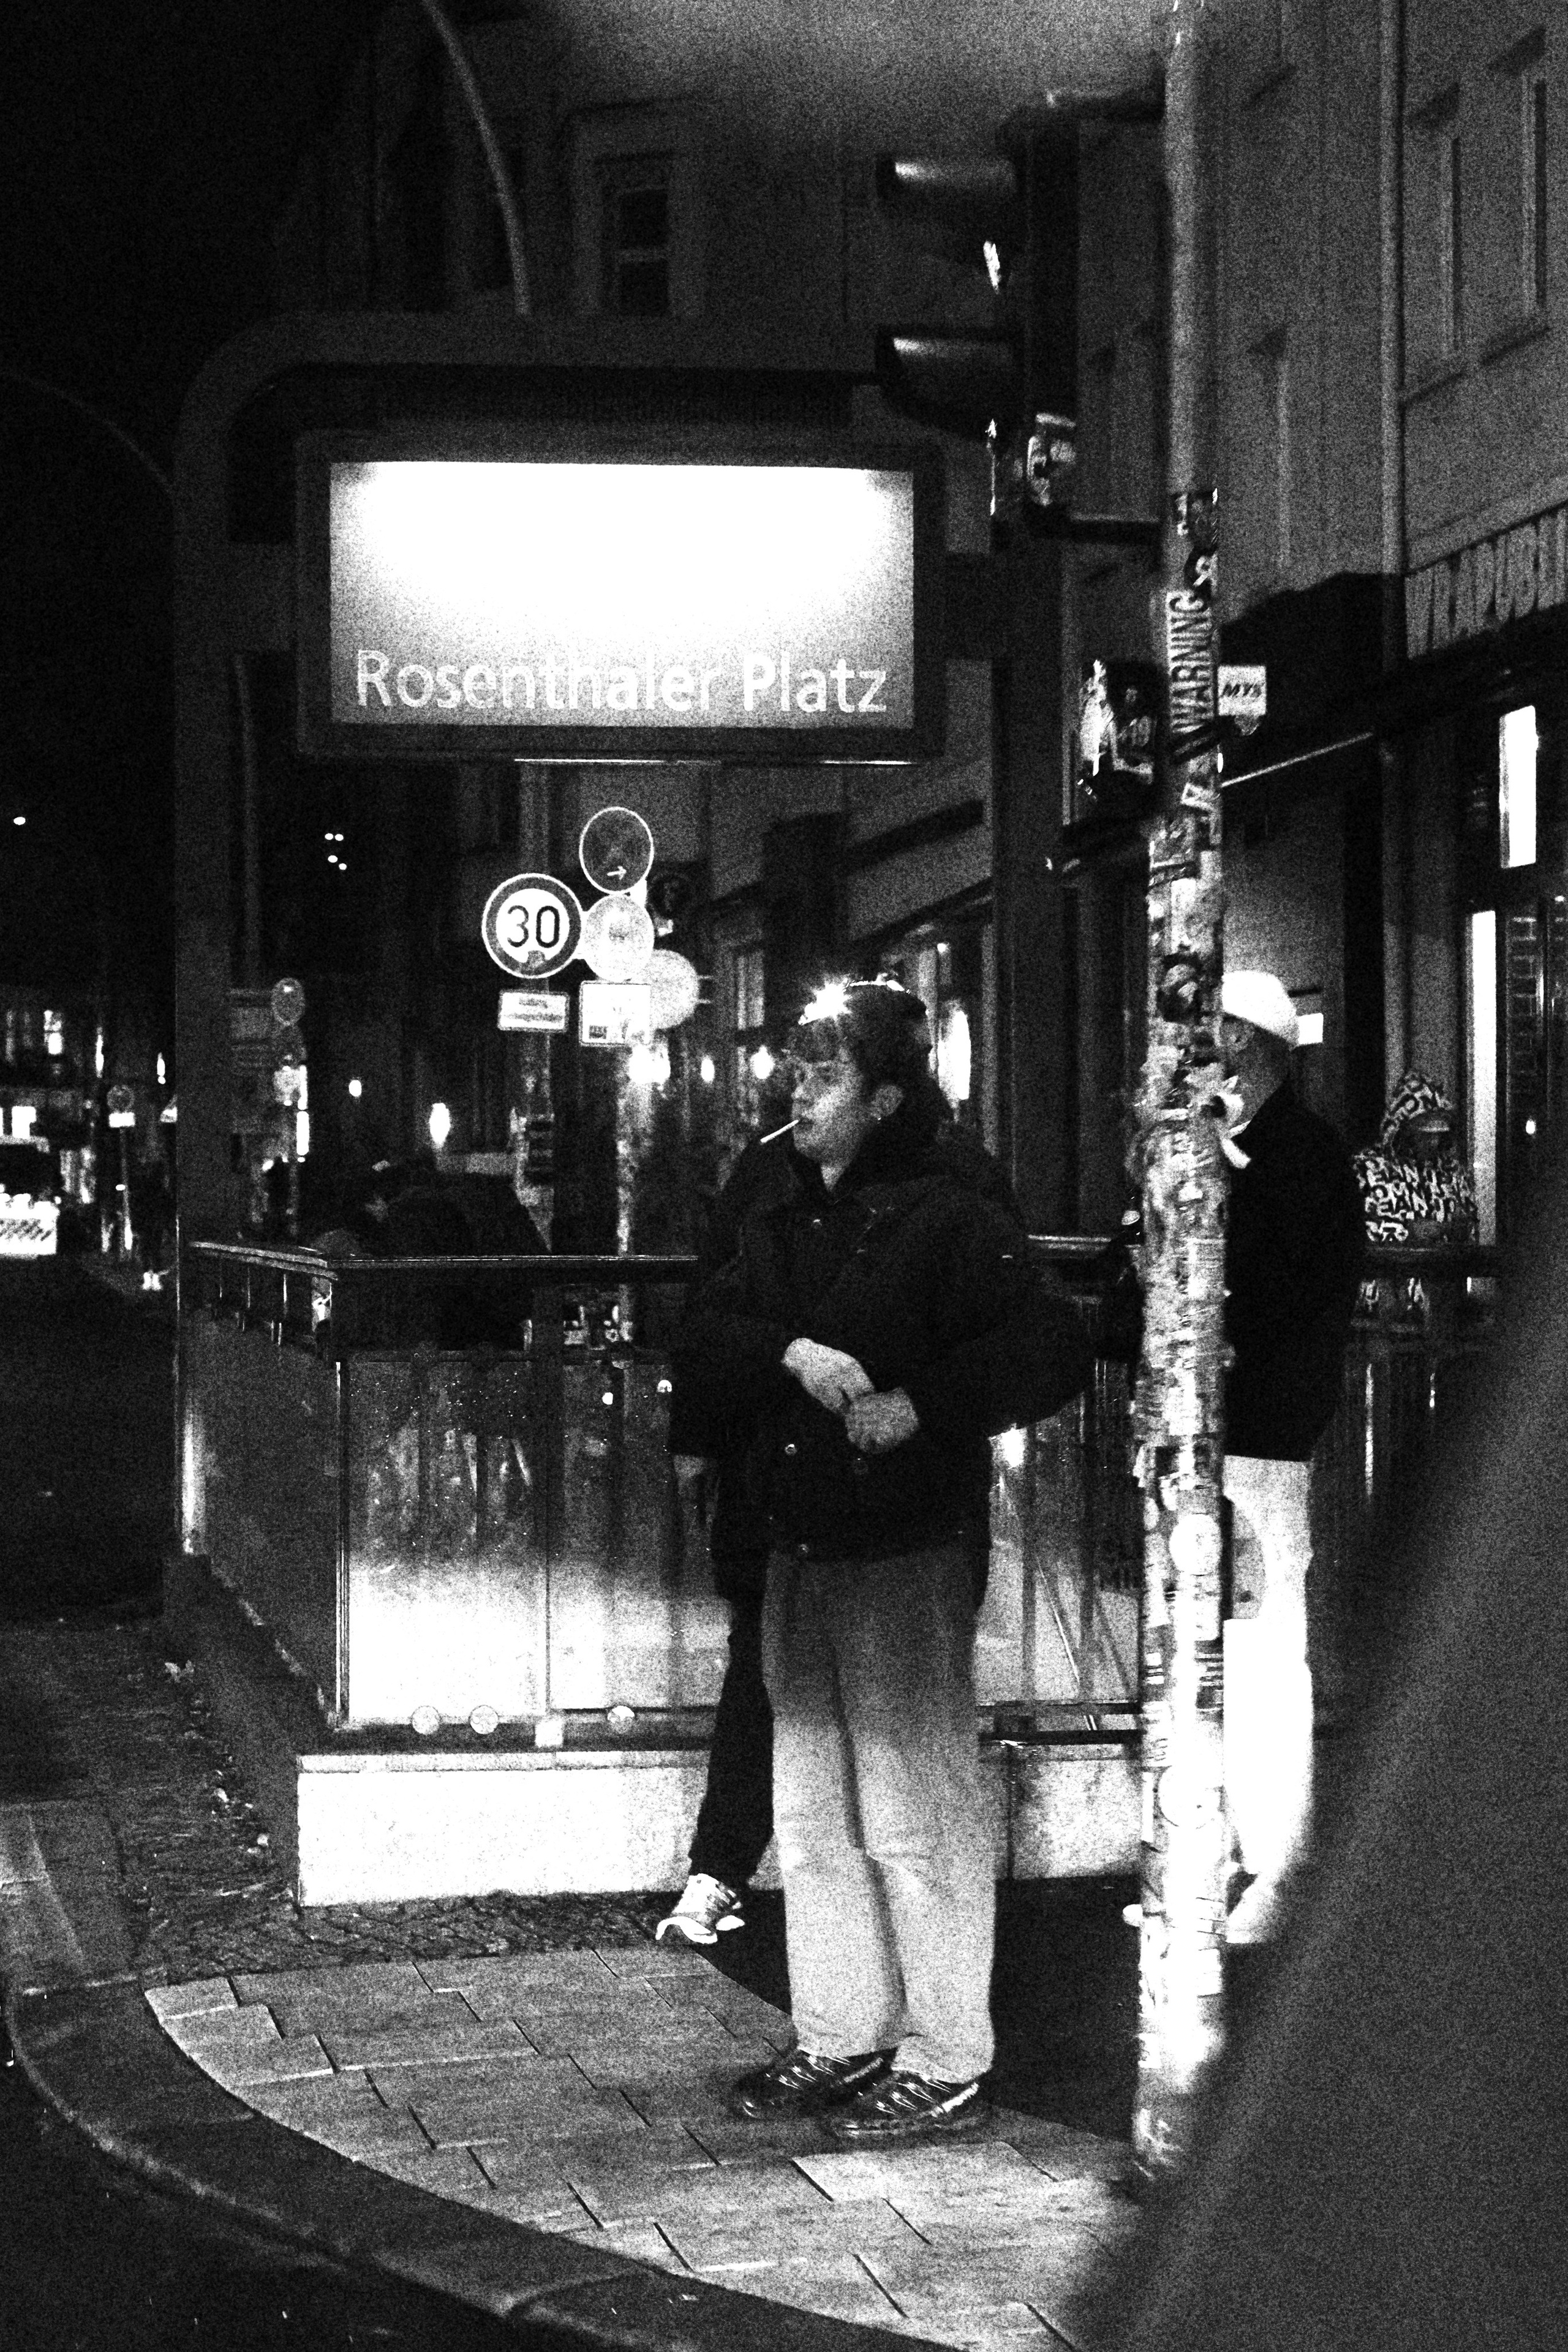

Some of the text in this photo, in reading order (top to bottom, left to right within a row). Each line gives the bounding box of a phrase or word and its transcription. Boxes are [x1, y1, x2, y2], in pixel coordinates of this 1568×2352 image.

[356, 649, 888, 714] Rosenthaler Platz
[507, 905, 560, 949] 30
